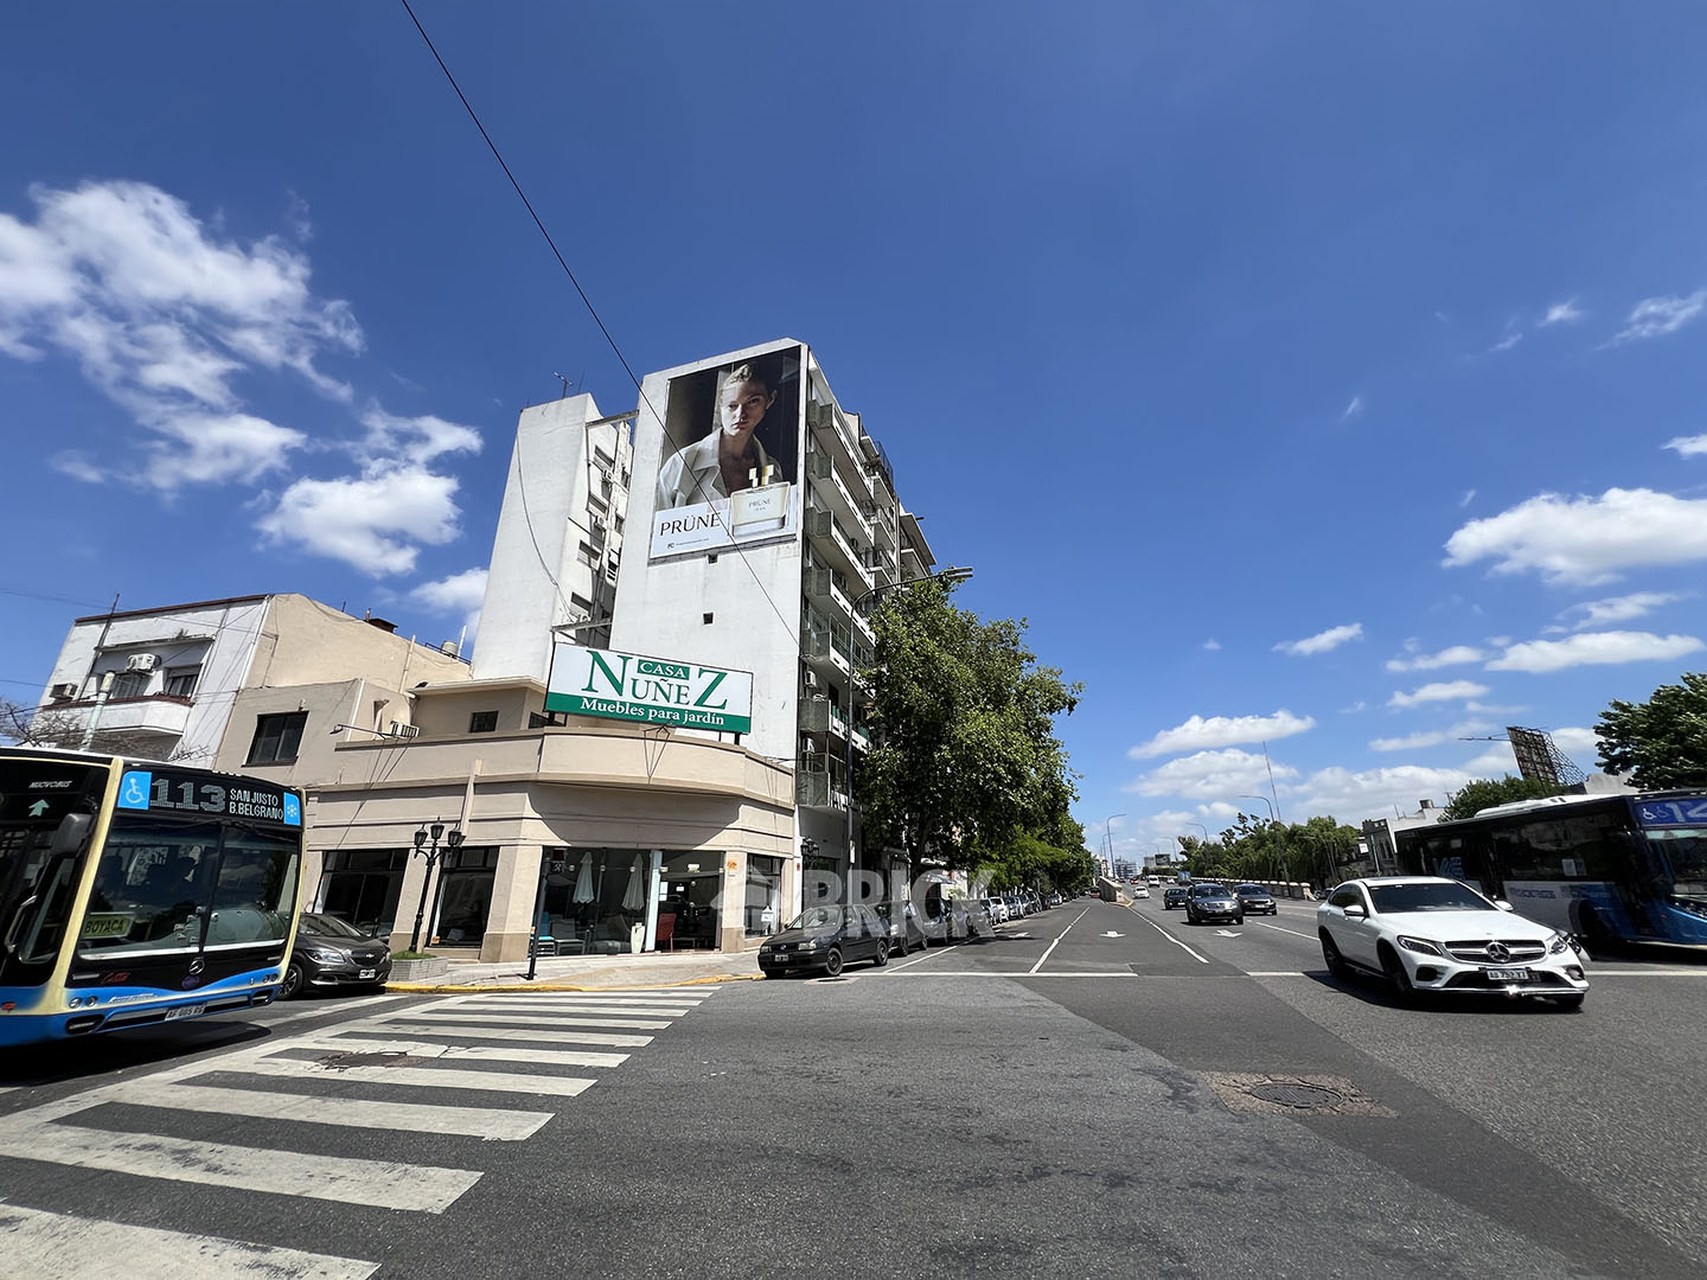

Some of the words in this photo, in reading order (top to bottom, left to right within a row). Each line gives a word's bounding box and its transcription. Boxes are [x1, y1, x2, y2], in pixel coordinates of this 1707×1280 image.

[660, 511, 721, 536] PRÜNE
[639, 661, 687, 678] CASA
[580, 697, 645, 717] Muebles
[648, 707, 680, 721] para
[682, 710, 725, 726] jardín
[149, 778, 226, 813] 113
[230, 788, 249, 802] SAN
[252, 790, 279, 807] JUSTO
[229, 802, 284, 820] B.BELGRANO
[84, 919, 124, 934] BOYACA
